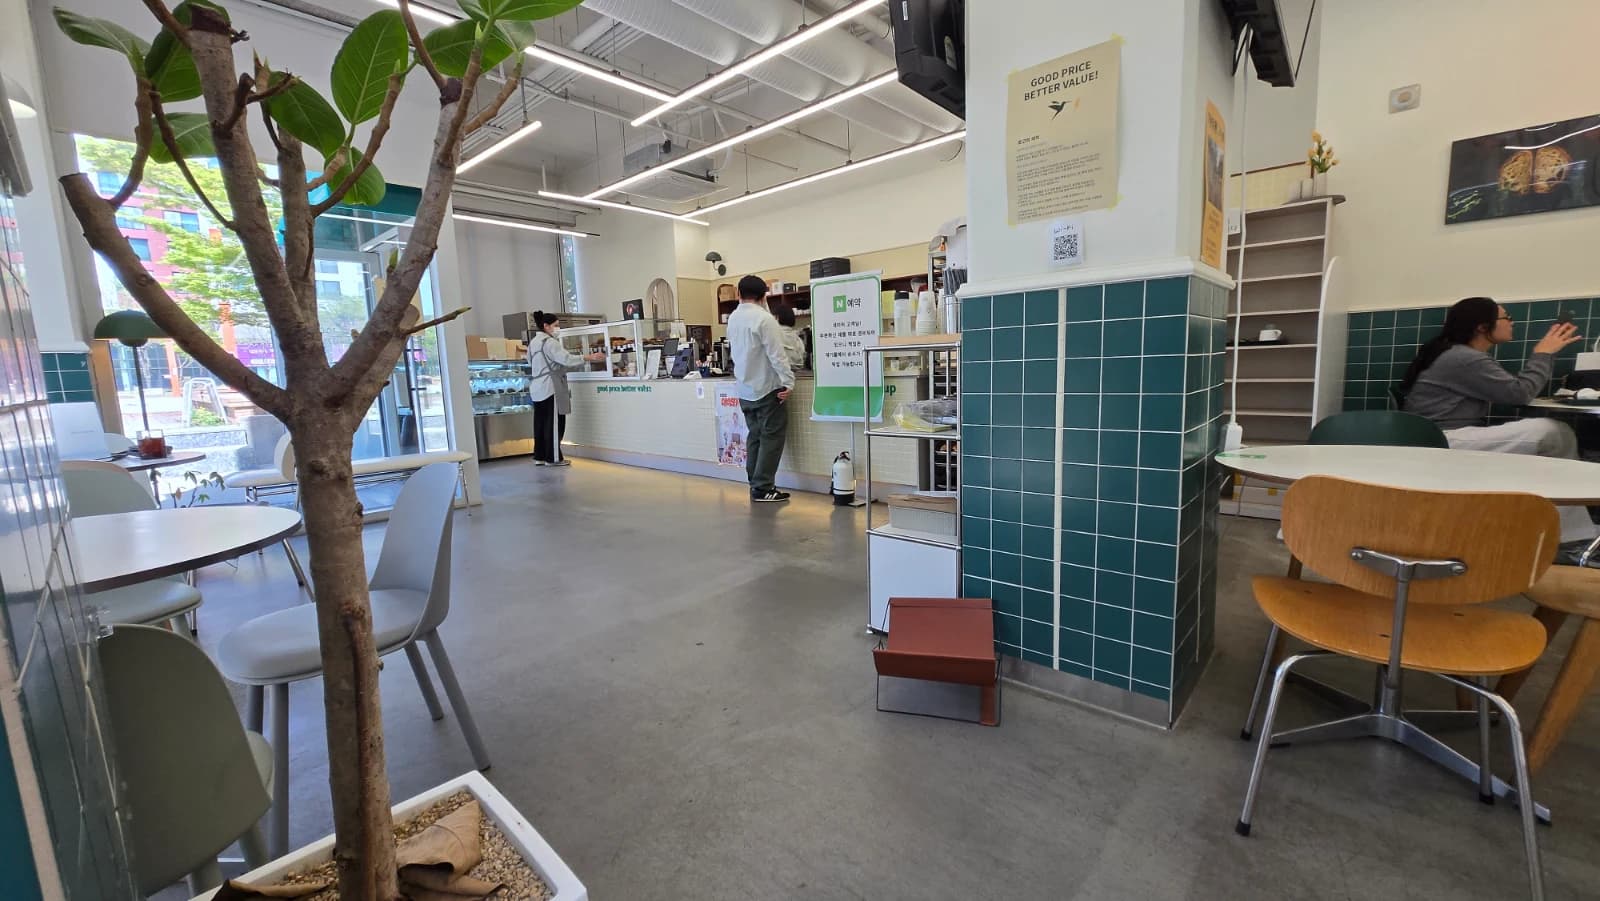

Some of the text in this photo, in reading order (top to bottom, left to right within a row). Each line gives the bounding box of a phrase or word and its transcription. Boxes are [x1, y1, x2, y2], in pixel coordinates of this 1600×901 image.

[1024, 70, 1098, 101] BETTER VALUE!
[1030, 60, 1092, 87] GOOD PRICE
[847, 298, 861, 308] 예약
